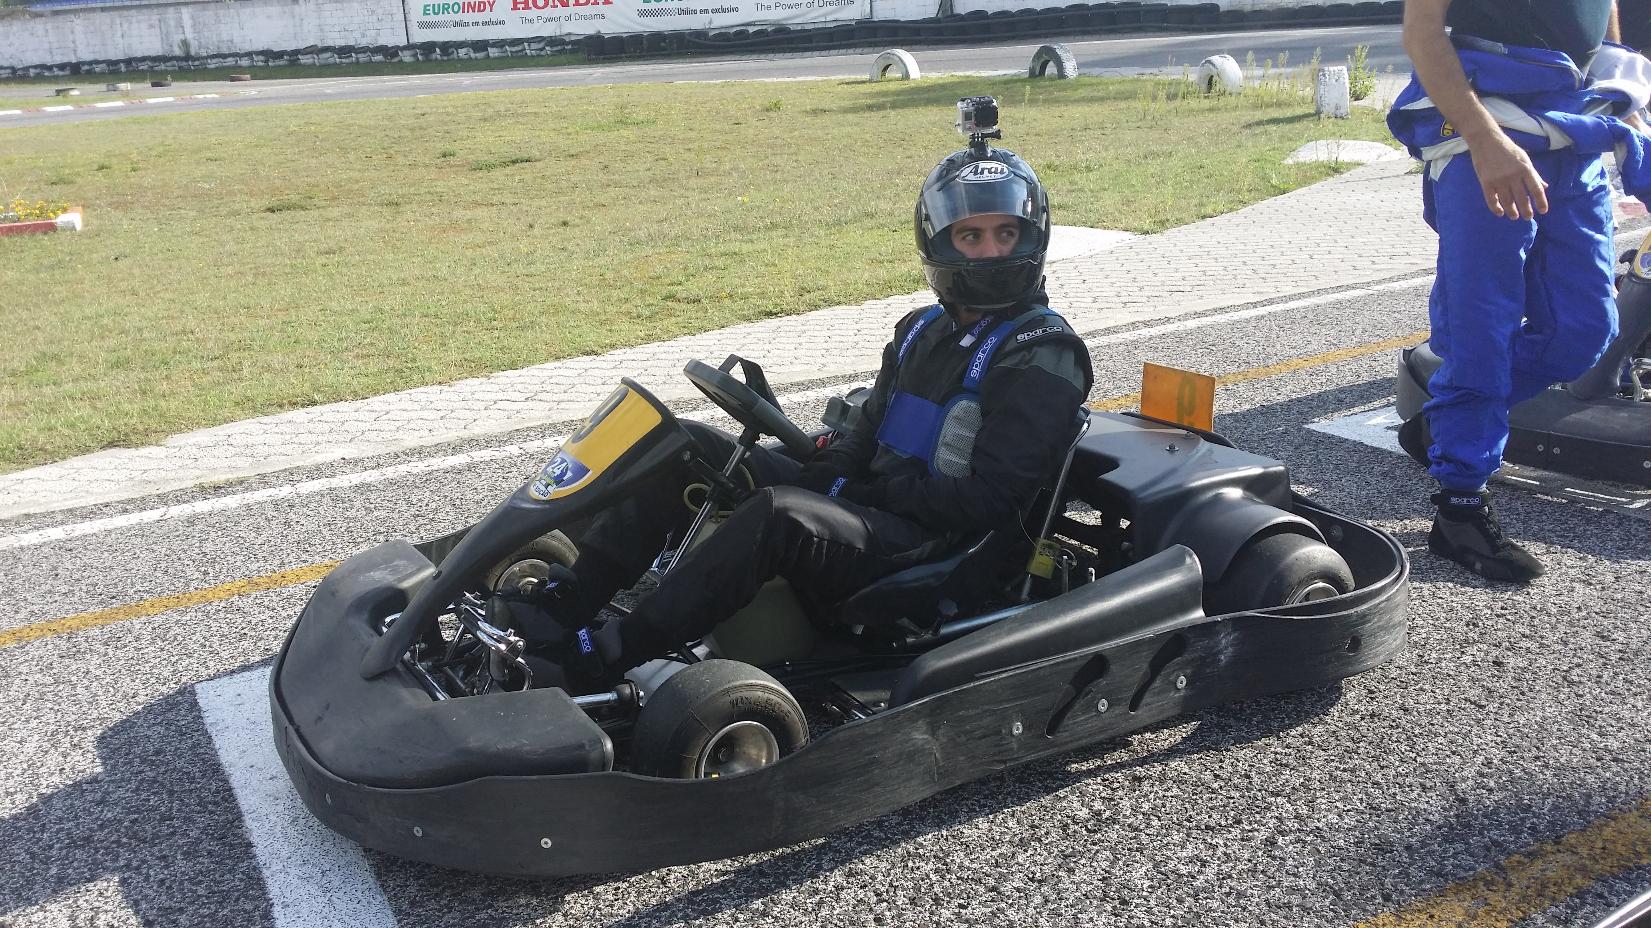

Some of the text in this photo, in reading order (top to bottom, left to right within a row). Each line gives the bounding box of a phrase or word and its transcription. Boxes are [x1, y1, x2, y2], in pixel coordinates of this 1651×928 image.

[422, 1, 496, 16] EUROINDY
[710, 4, 739, 15] exclusivo
[756, 0, 855, 12] The Power of Dreams
[520, 12, 606, 25] The Power of Dreams
[961, 164, 1005, 179] Arai
[1016, 325, 1063, 344] sparco
[970, 336, 997, 380] sparco
[1450, 496, 1480, 505] sparco
